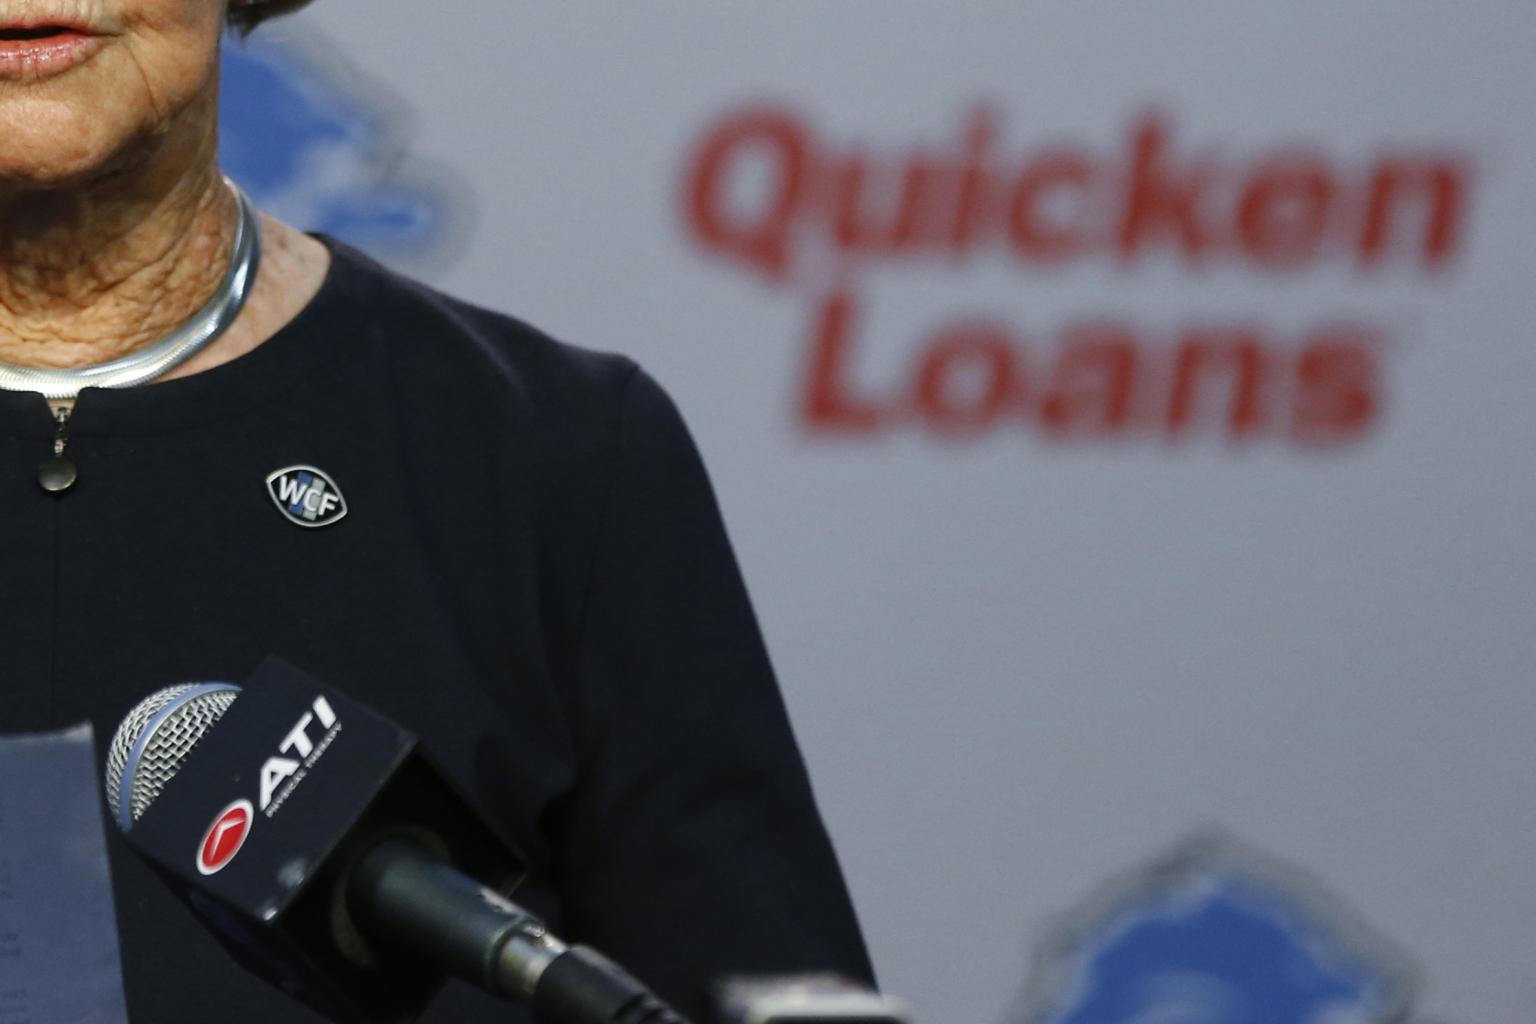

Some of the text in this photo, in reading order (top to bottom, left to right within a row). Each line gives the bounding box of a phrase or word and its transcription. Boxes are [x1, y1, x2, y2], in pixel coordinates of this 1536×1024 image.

[679, 107, 1468, 282] Quicken
[795, 285, 1380, 442] Loans
[279, 475, 339, 515] WCF
[259, 694, 337, 812] ATI
